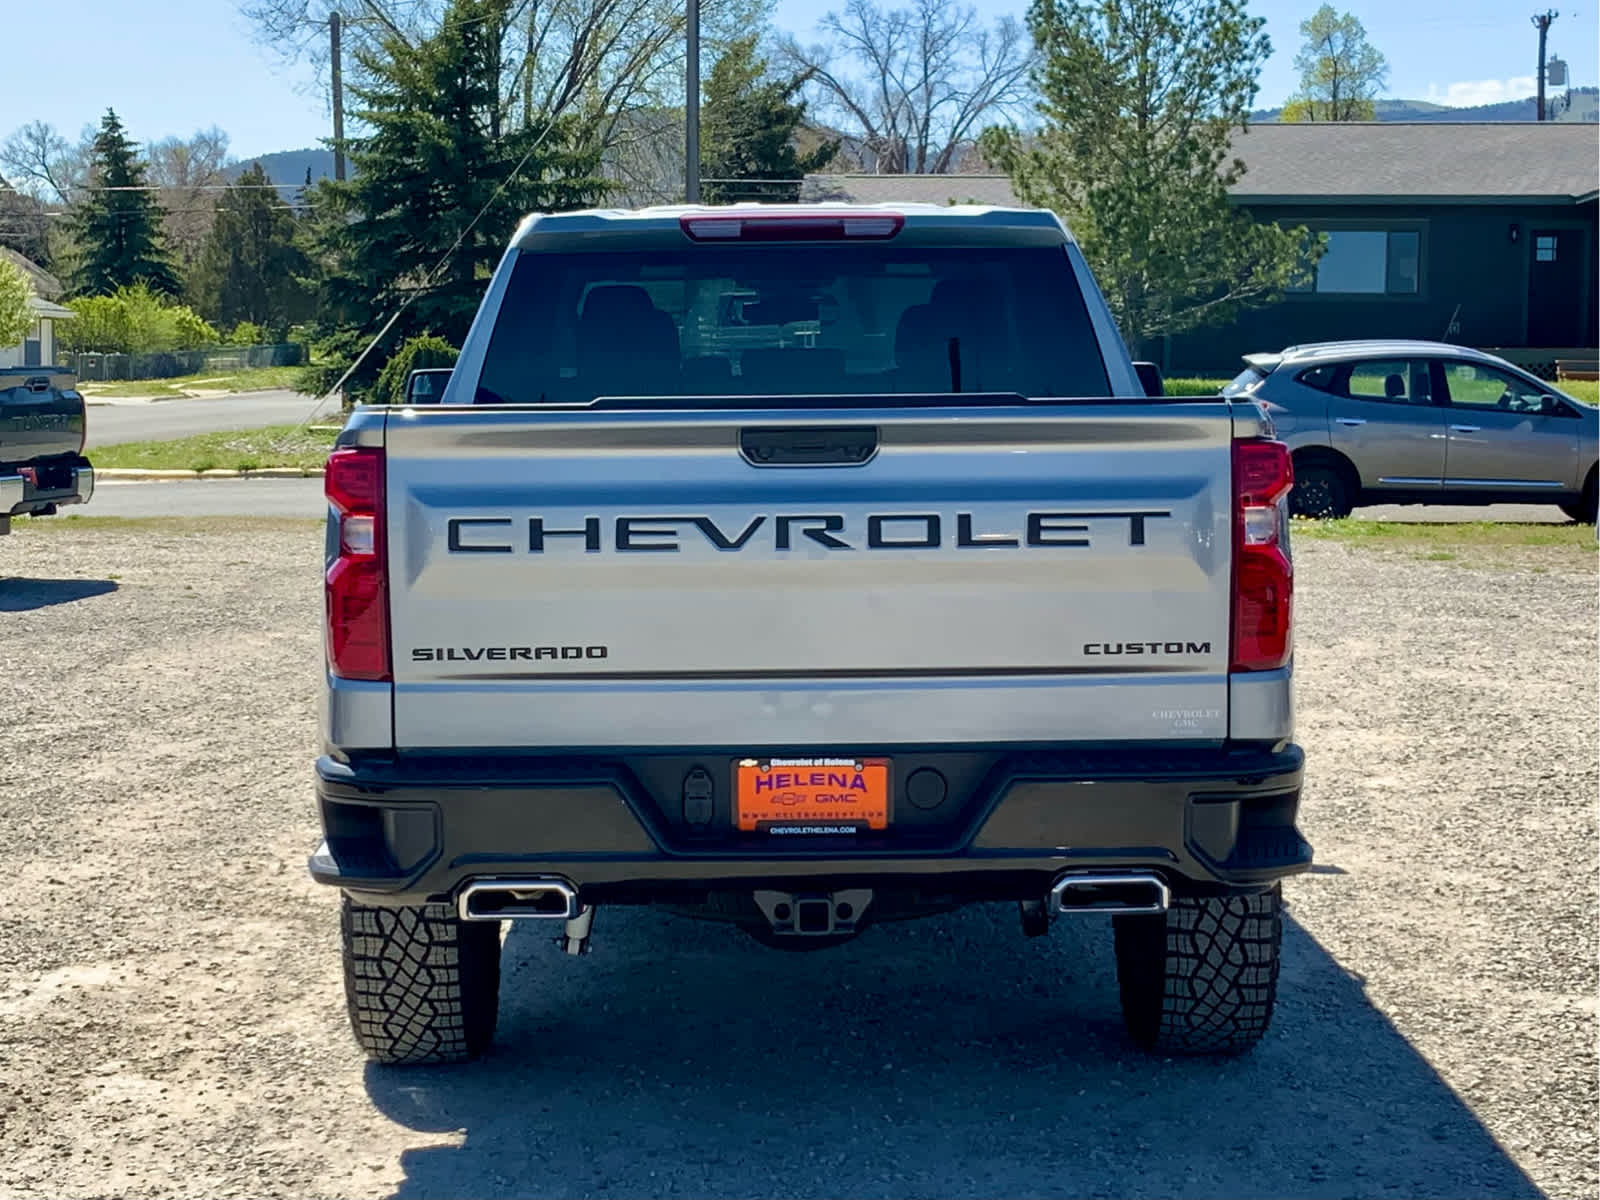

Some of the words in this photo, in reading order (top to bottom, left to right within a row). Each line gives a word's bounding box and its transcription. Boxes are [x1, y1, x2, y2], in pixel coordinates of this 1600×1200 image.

[447, 510, 1171, 552] CHEVROLET
[411, 647, 608, 661] SILVERADO
[1083, 642, 1211, 655] CUSTOM
[755, 773, 868, 794] HELENA
[815, 794, 857, 804] GMC
